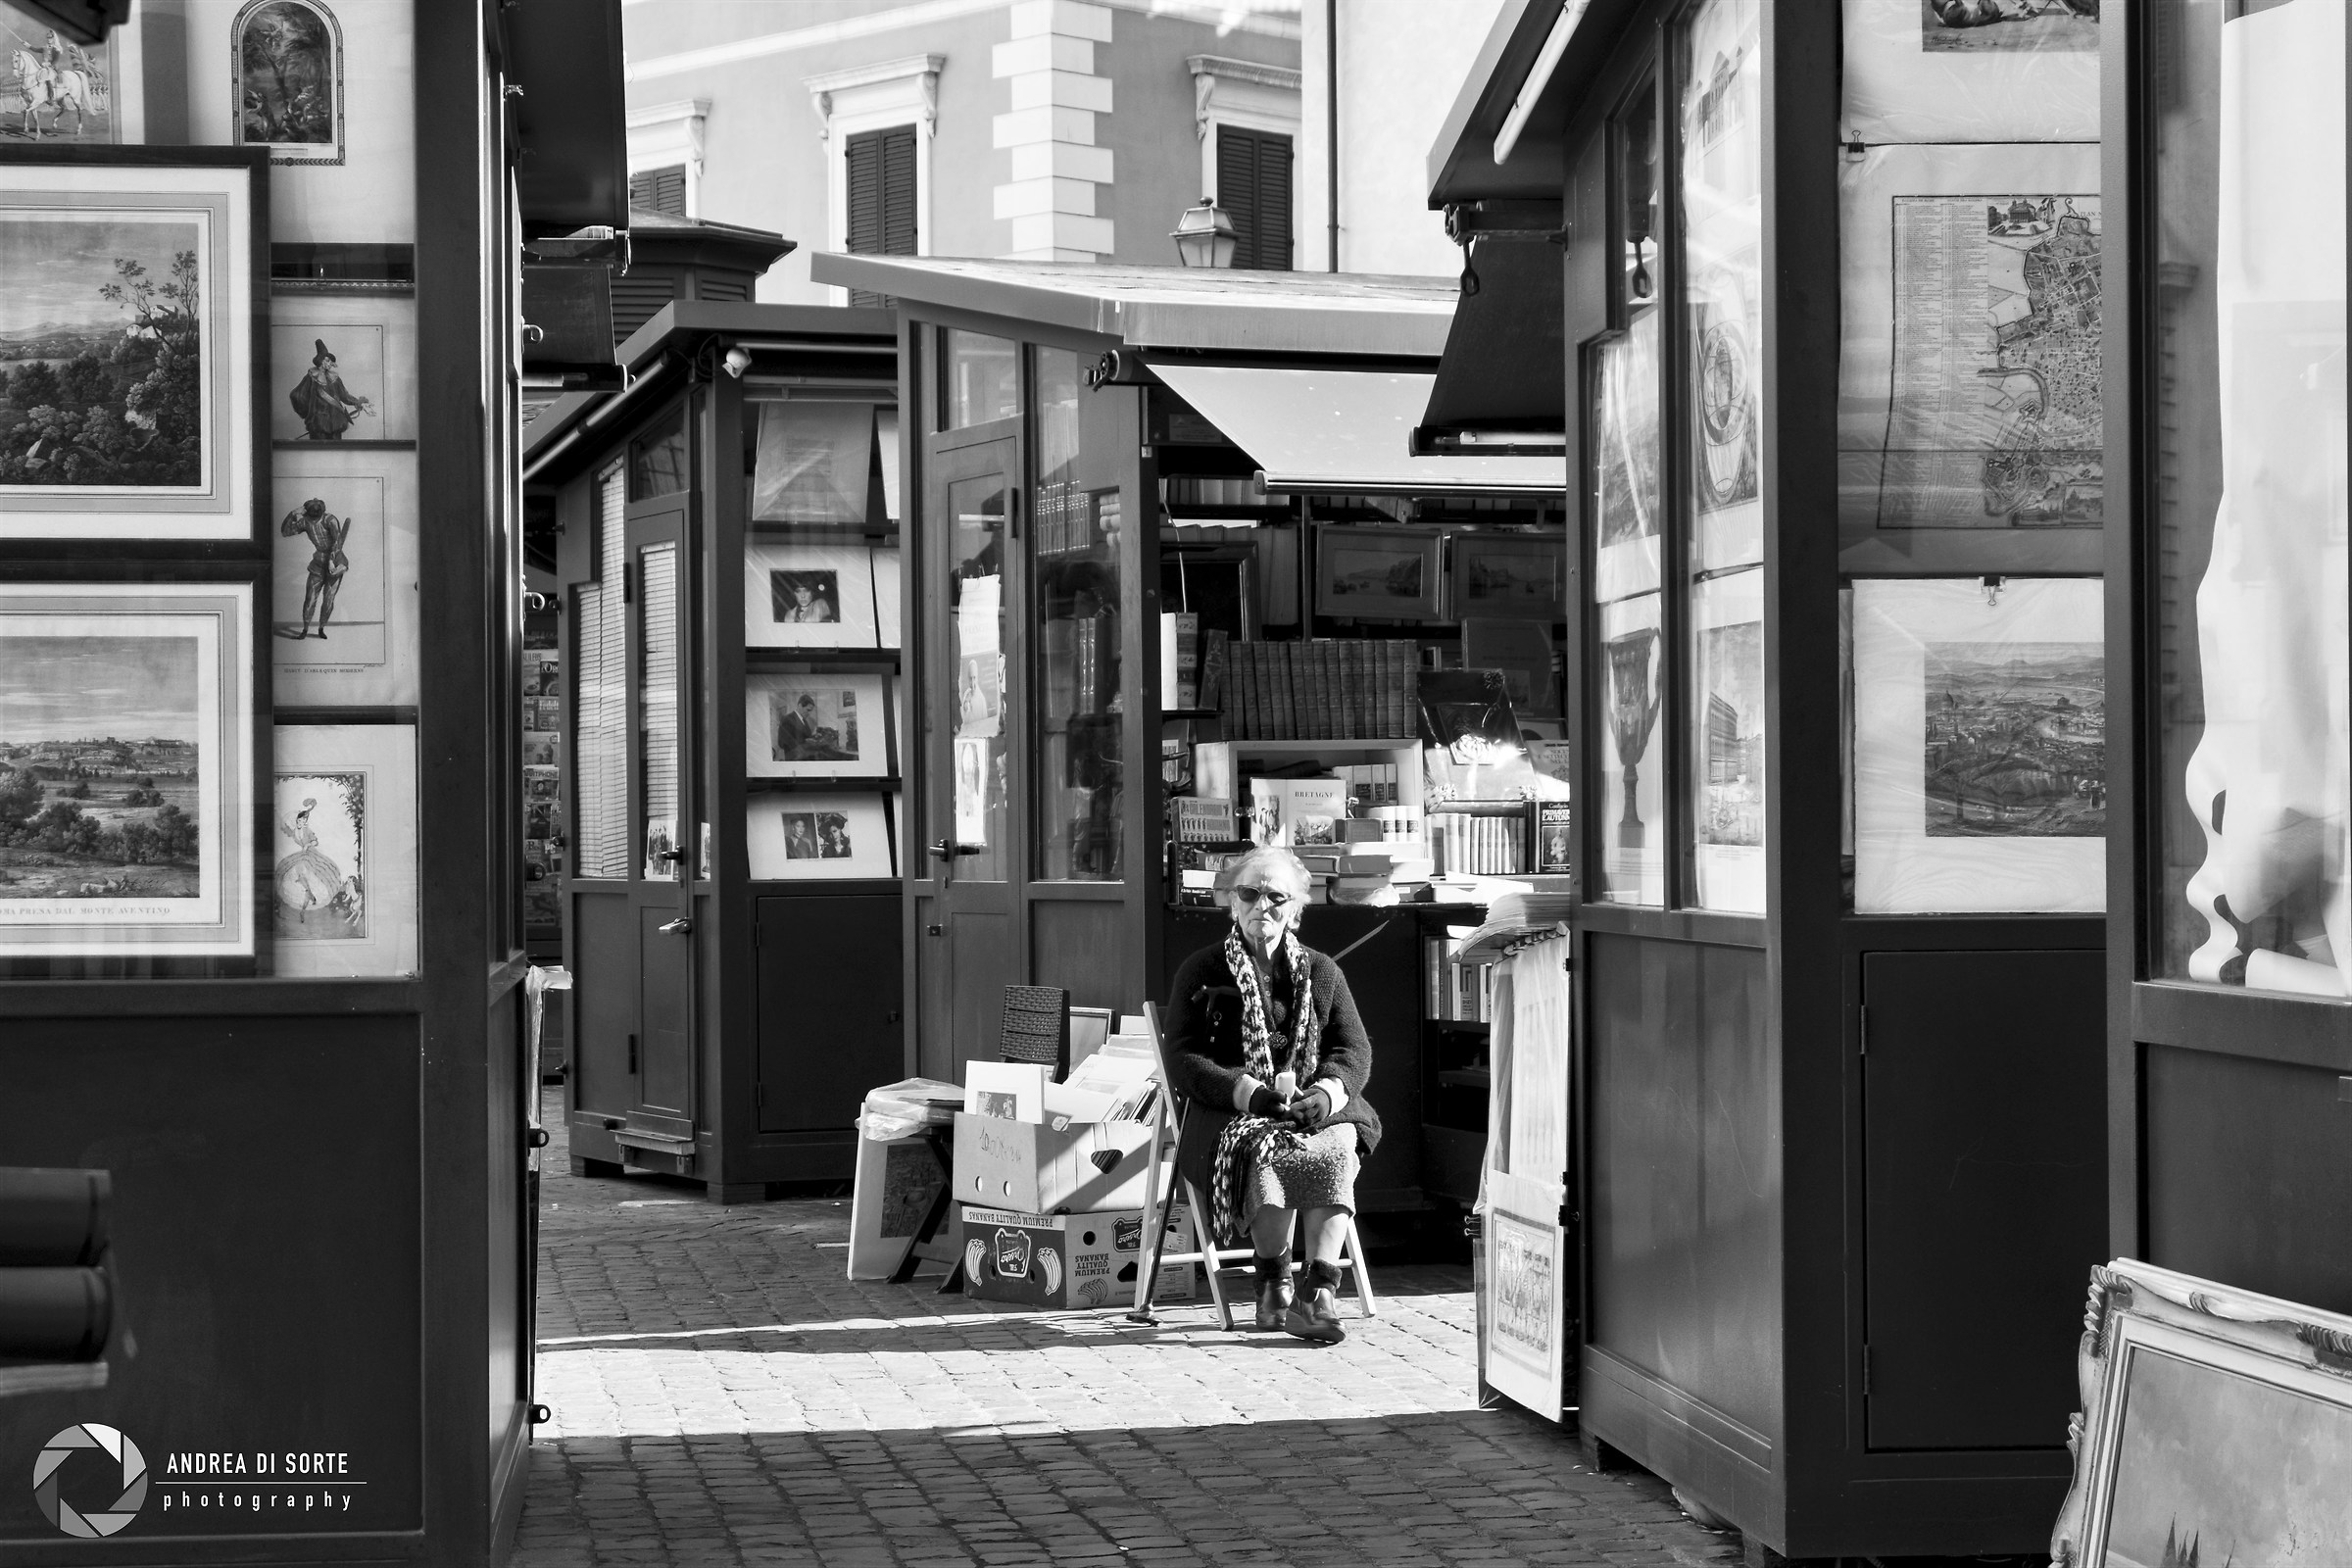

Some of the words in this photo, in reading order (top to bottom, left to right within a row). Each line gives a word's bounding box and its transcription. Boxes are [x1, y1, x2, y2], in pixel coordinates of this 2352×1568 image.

[80, 906, 114, 915] MONTE
[119, 906, 171, 915] AVENTINO
[968, 1211, 995, 1222] BANANAS
[995, 1213, 1022, 1224] QUALITY
[1022, 1216, 1054, 1228] PREMIUM
[1074, 1252, 1109, 1263] BANANAS
[1076, 1259, 1108, 1269] QUALITY
[1074, 1267, 1110, 1277] PREMIUM
